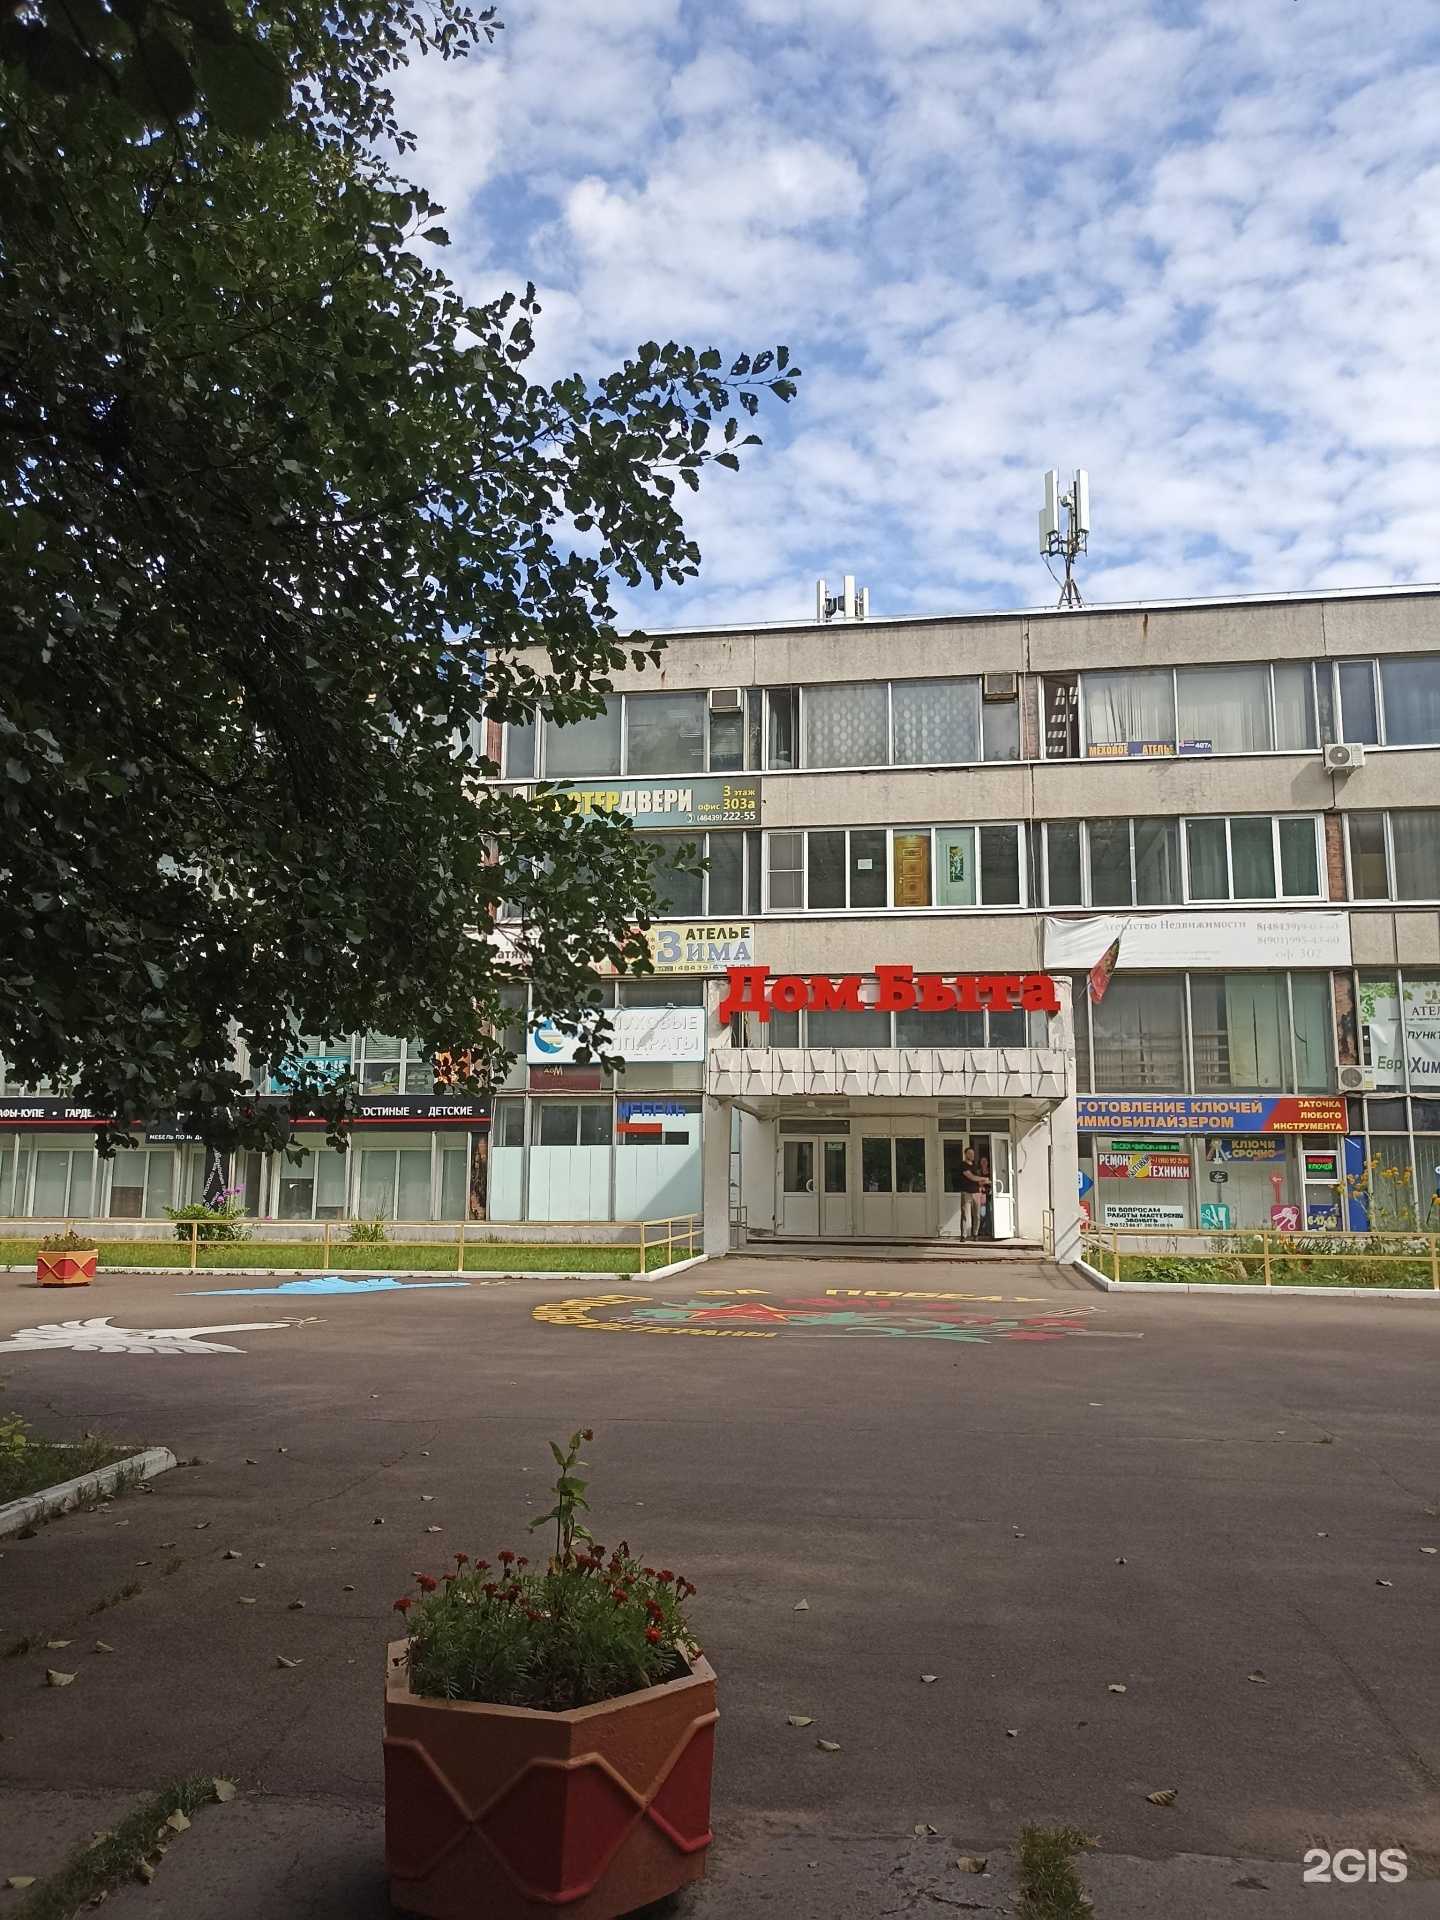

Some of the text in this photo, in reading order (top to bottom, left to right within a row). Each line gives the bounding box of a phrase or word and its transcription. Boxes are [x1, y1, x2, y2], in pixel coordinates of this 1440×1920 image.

[1088, 745, 1128, 757] МЕХОВОЕ
[723, 785, 730, 797] 3
[723, 798, 755, 810] 303а
[685, 926, 751, 940] АТЕЛЬЕ
[720, 965, 1060, 1024] Дом Быта
[1190, 1100, 1263, 1114] КЛЮЧЕЙ
[1298, 1100, 1341, 1109] ЗАТОЧКА
[428, 1106, 473, 1117] ДЕТСКИЕ
[1300, 1110, 1342, 1119] ЛЮБОГО
[1272, 1121, 1343, 1131] ИНСТРУМЕНТА
[1231, 1140, 1276, 1149] КЛЮЧИ
[1231, 1149, 1276, 1158] СРОЧНО
[1099, 1154, 1133, 1166] РЕМОНТ
[1148, 1165, 1190, 1178] ТЕХНИКИ
[825, 1288, 1049, 1302] ПОБЕДУ
